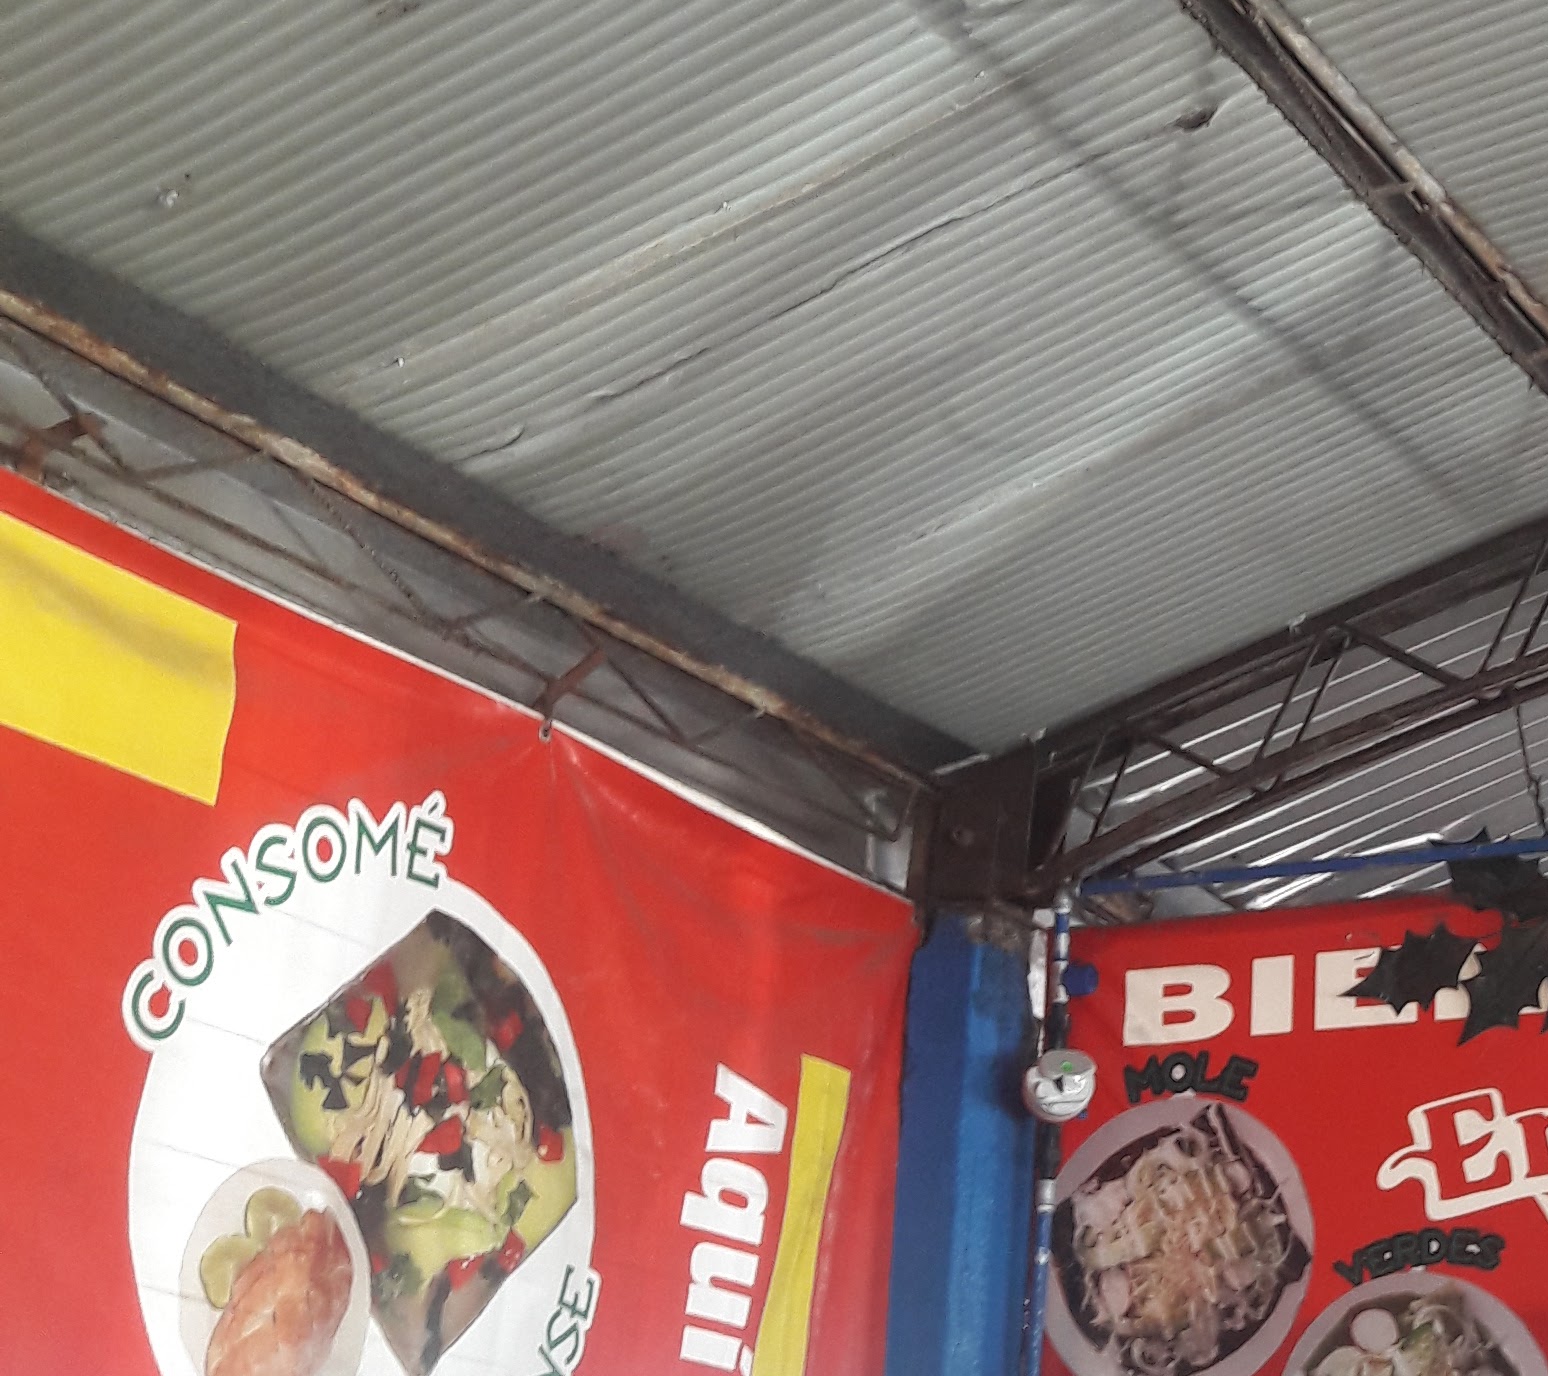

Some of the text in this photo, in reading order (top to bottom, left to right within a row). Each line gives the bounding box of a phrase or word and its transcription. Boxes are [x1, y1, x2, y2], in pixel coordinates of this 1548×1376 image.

[133, 796, 447, 1042] CONSOMÉ
[1123, 1050, 1260, 1104] MOLE
[1333, 1230, 1506, 1287] VERDES
